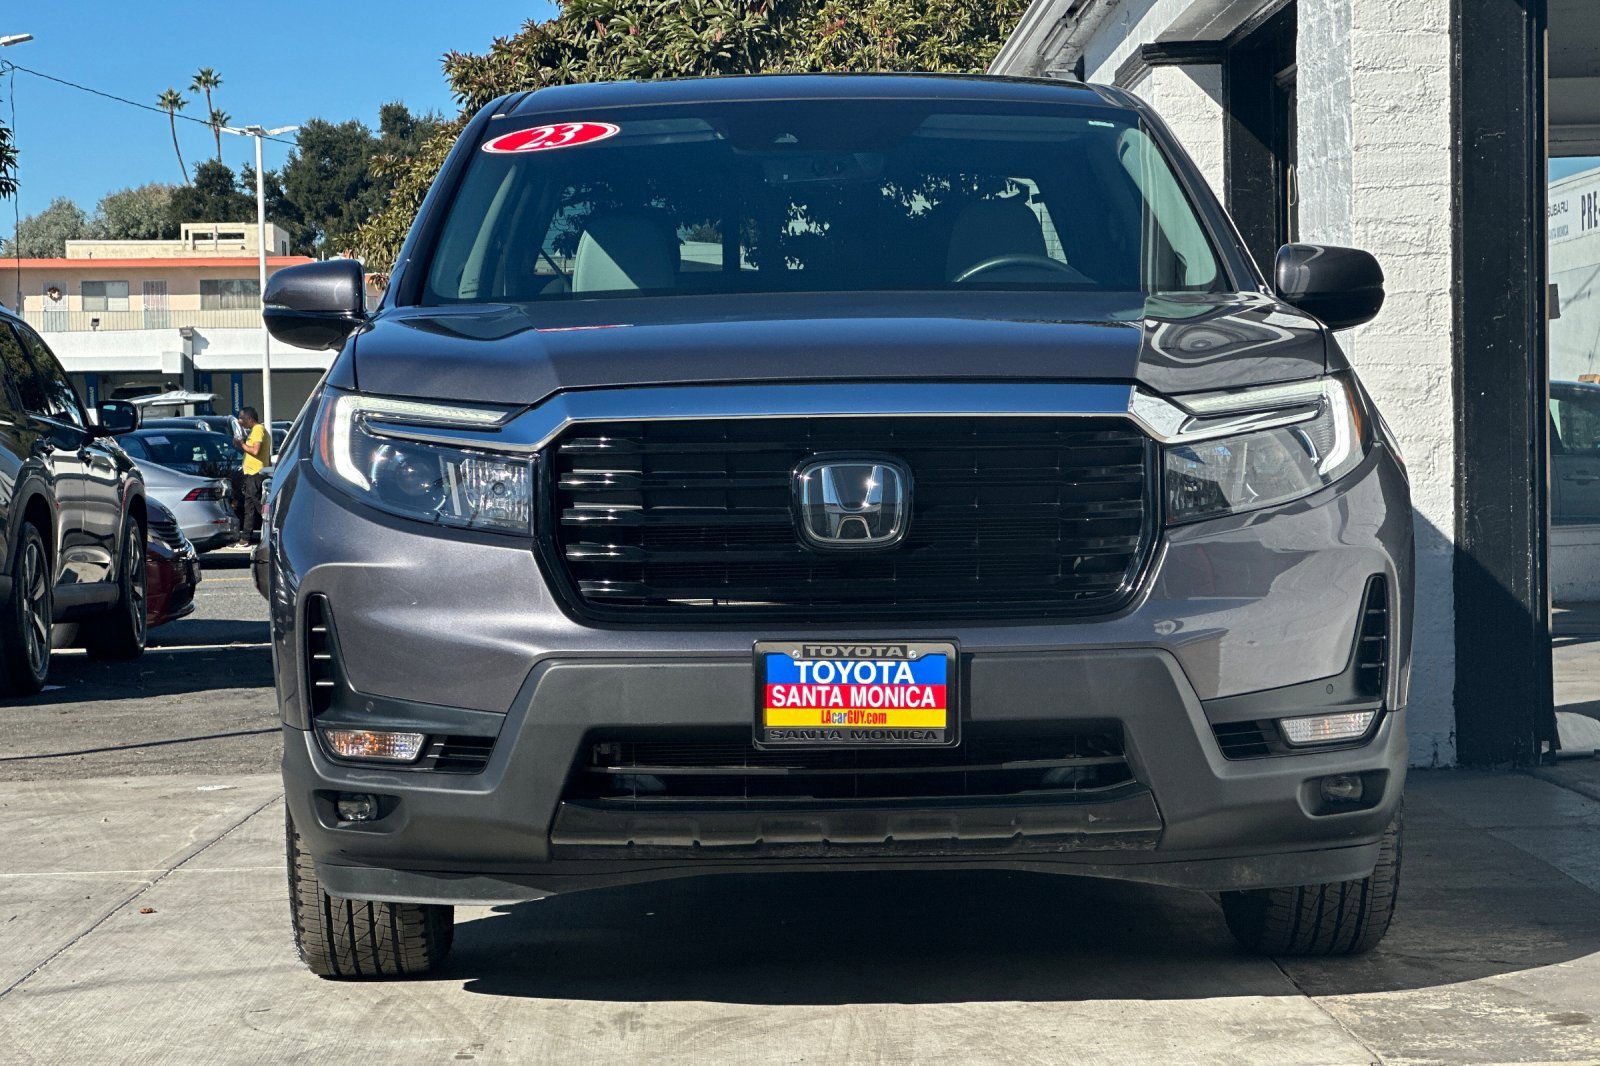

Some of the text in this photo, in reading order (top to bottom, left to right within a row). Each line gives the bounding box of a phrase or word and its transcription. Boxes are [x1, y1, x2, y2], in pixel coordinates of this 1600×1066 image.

[515, 124, 584, 150] 23
[805, 645, 904, 657] TOYOTA
[793, 661, 915, 684] TOYOTA
[771, 685, 936, 707] SANTA MONICA
[820, 710, 887, 724] LAcarGUY.com
[769, 729, 938, 741] SANTA MONICA
